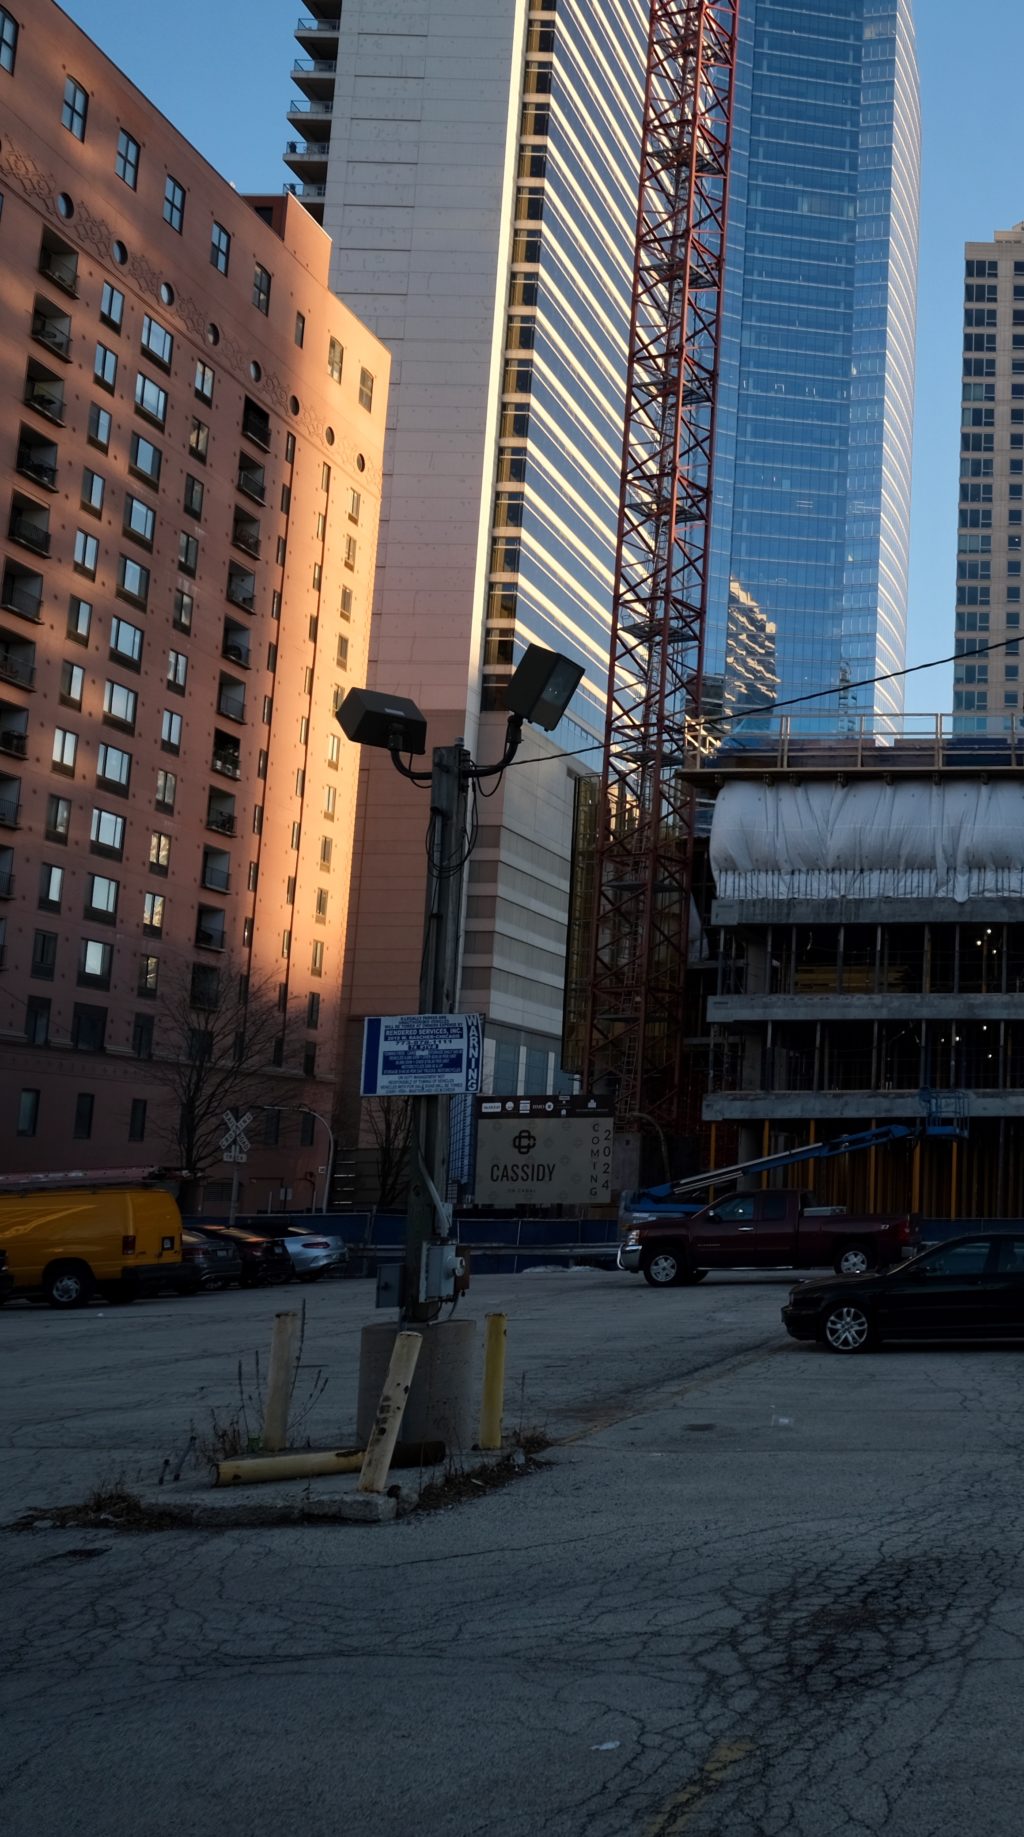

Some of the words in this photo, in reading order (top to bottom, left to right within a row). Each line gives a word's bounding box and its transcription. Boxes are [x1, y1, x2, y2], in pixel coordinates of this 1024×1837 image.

[466, 1015, 480, 1091] WARNING
[491, 1163, 556, 1182] CASSIDY
[589, 1123, 601, 1197] COMING
[602, 1130, 611, 1190] 2024
